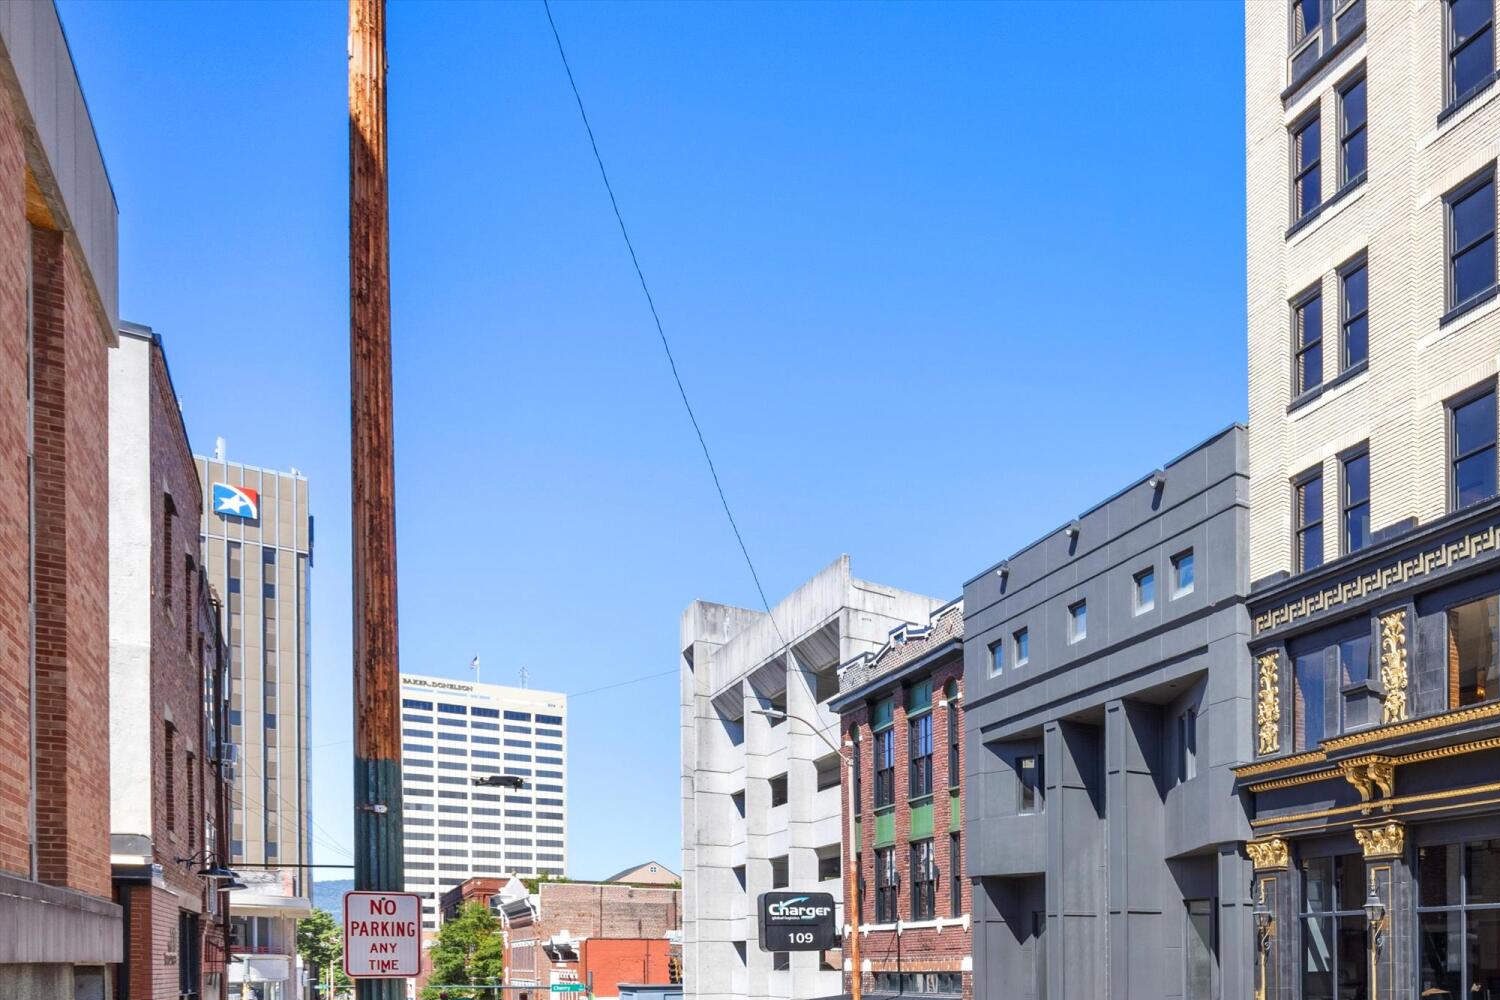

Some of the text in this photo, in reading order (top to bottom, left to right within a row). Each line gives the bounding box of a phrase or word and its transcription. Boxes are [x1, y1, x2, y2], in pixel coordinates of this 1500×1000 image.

[370, 900, 396, 915] NO
[769, 901, 831, 918] Charger
[351, 921, 415, 937] PARKING
[788, 933, 813, 943] 109
[370, 943, 397, 953] ANY
[369, 960, 399, 970] TIME
